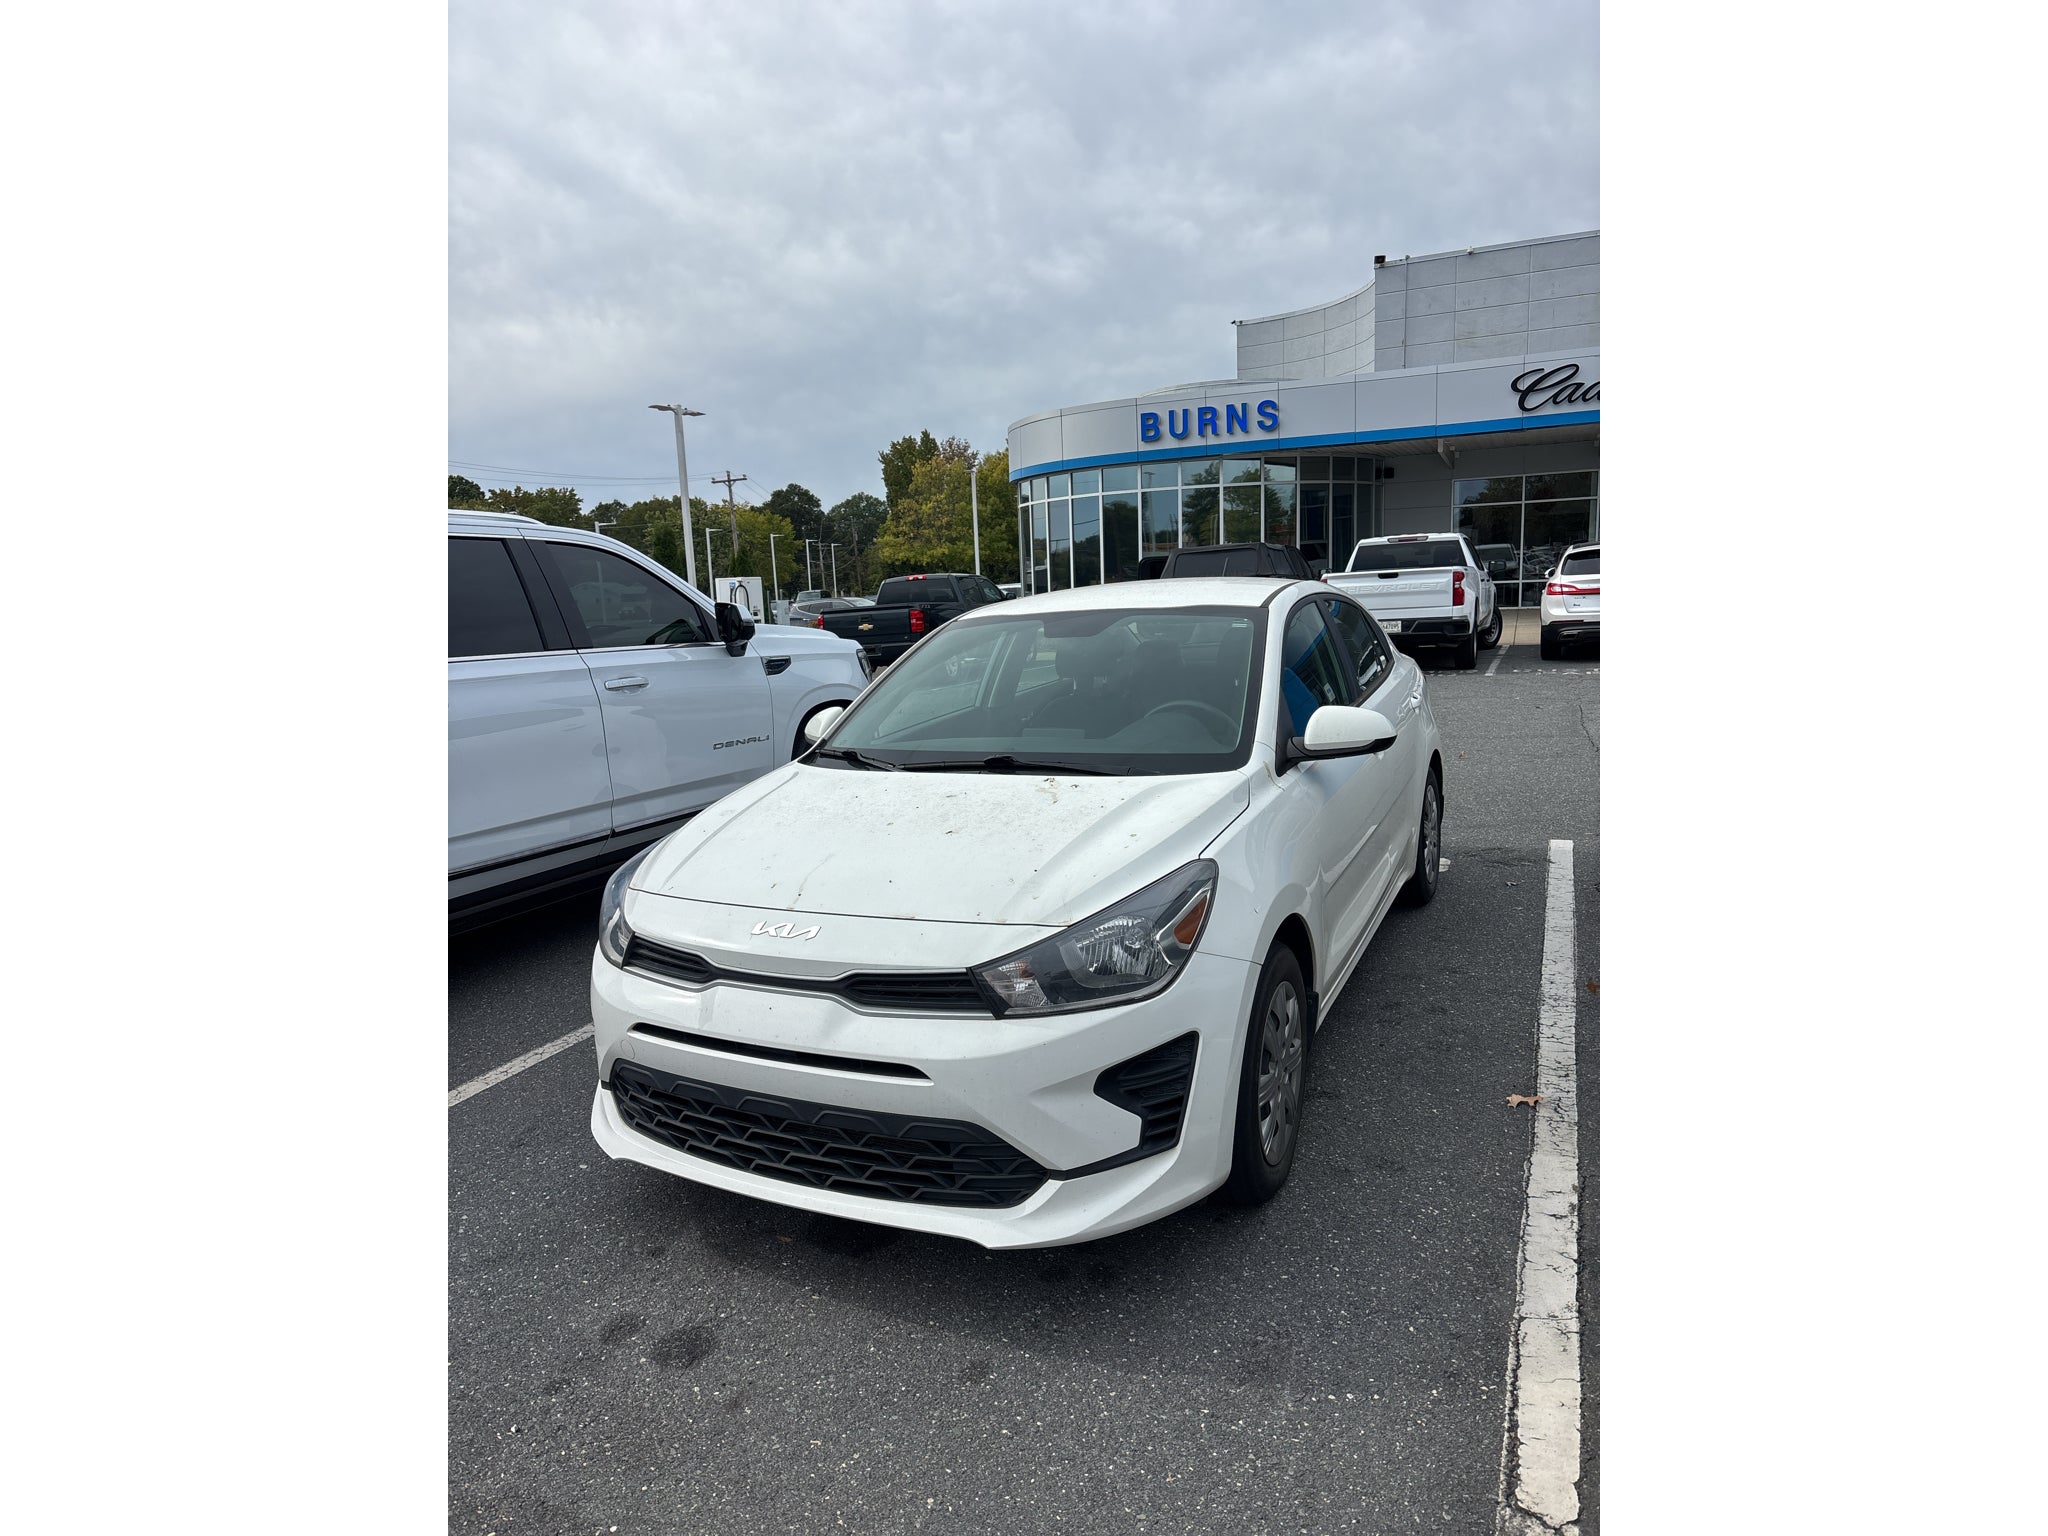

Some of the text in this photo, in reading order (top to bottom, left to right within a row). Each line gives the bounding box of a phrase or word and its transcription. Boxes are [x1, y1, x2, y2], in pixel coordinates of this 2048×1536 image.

[1140, 399, 1280, 442] BURNS
[712, 734, 770, 751] DENALI
[750, 920, 822, 941] KIA
